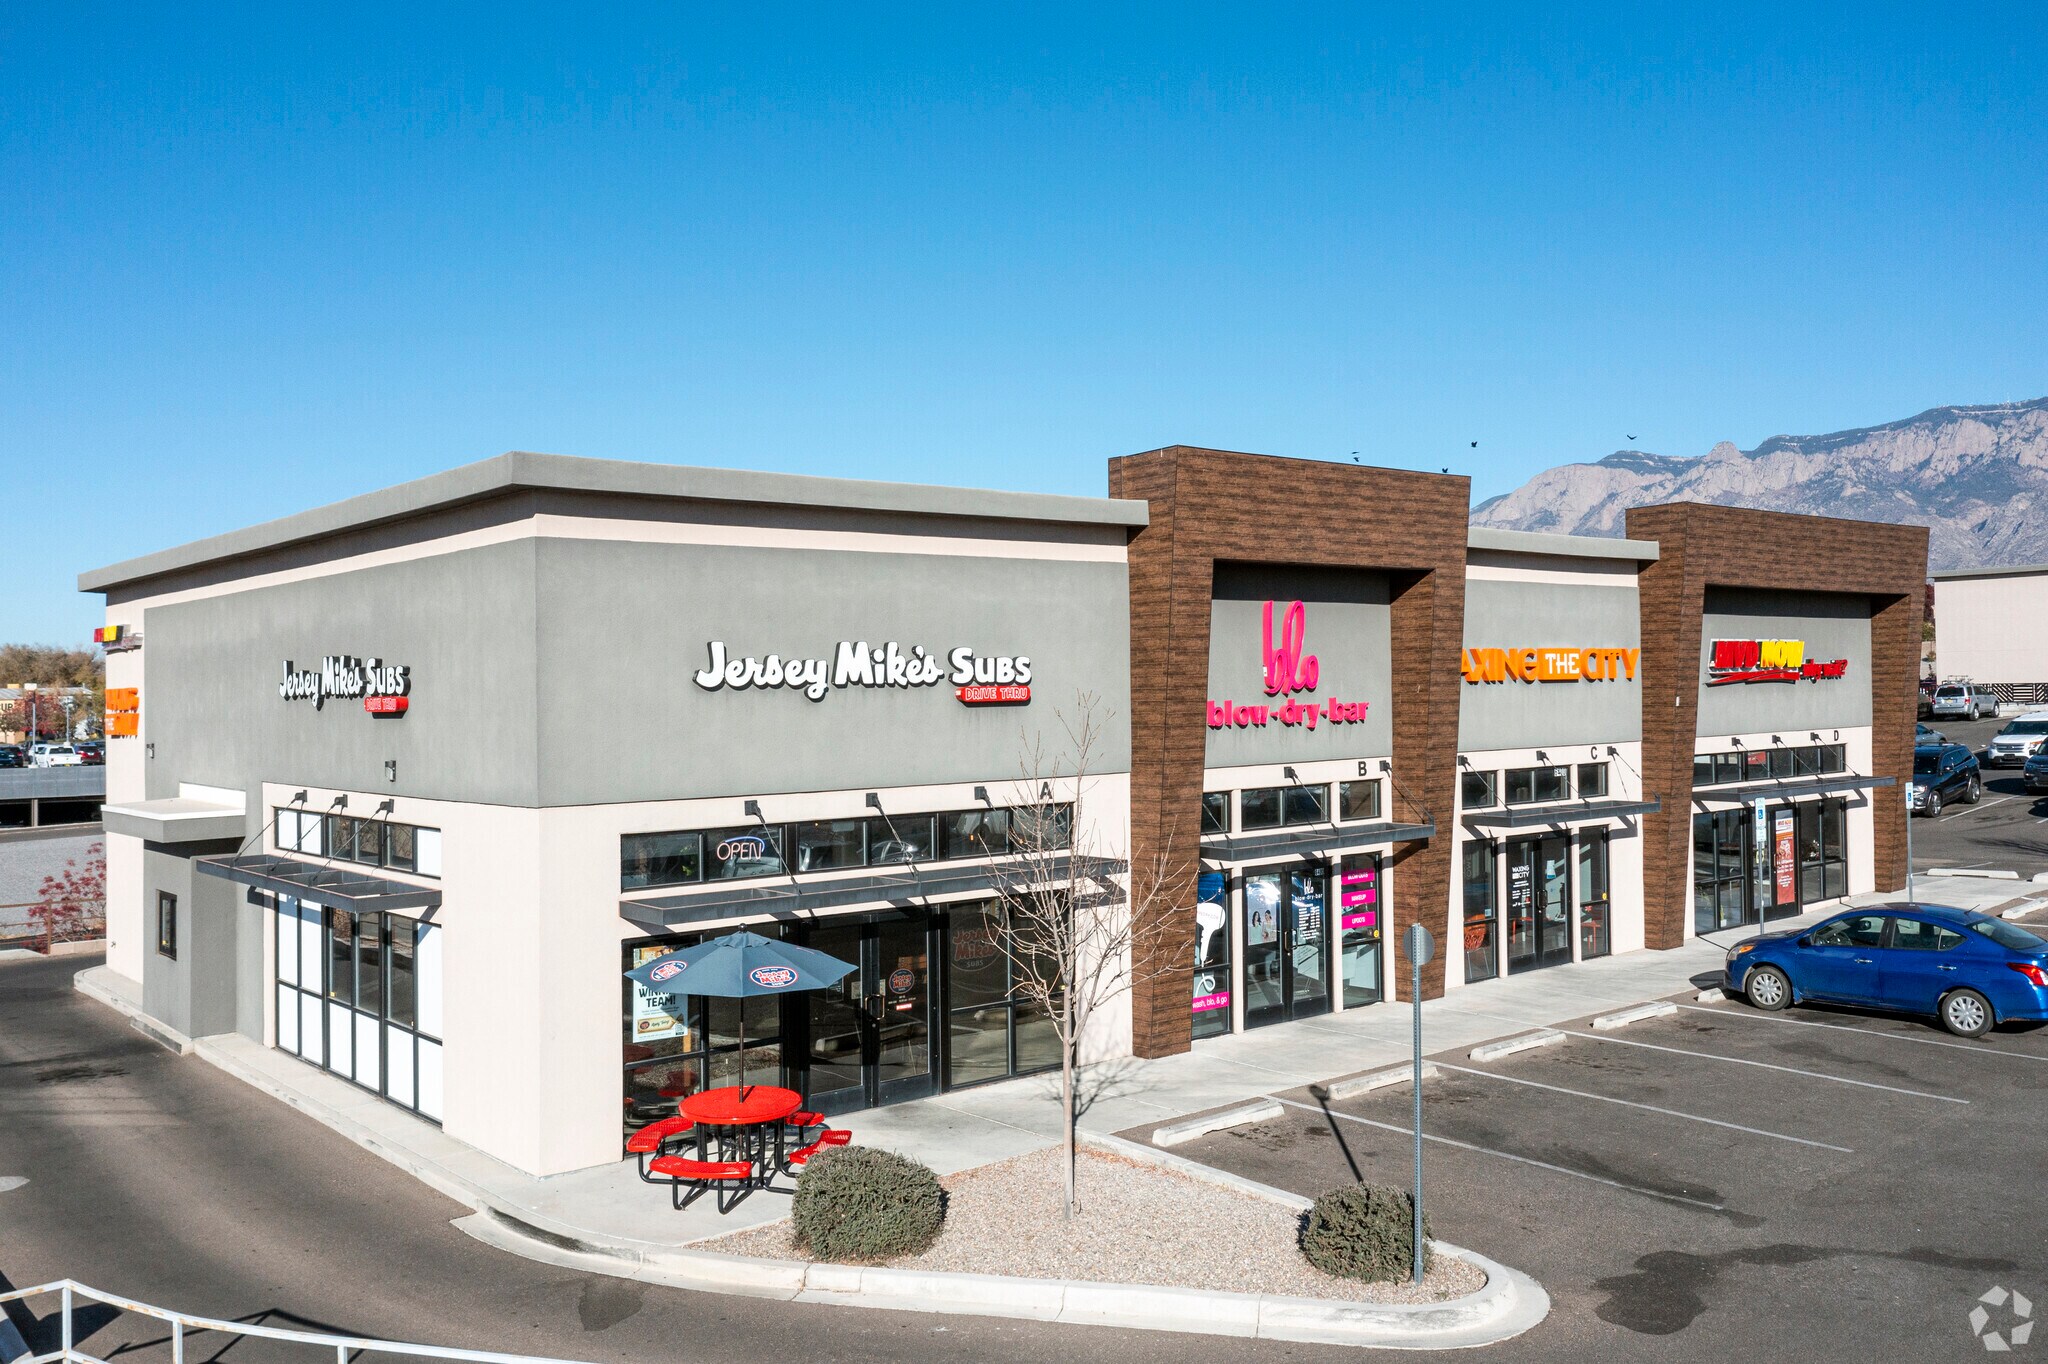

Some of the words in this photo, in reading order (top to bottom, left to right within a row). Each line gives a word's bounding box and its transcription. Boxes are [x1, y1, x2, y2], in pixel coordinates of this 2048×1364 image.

[1261, 600, 1319, 694] blo
[1715, 640, 1759, 668] MVD
[1760, 640, 1804, 668] NOW
[694, 641, 828, 699] Jersey
[833, 641, 944, 687] Mike's
[951, 646, 1032, 685] SUBS
[1461, 648, 1538, 682] AXING
[1545, 653, 1580, 674] THE
[1580, 647, 1640, 681] CITY
[280, 660, 319, 708] Jersey
[321, 656, 364, 697] Mike's
[965, 687, 997, 701] DRIVE
[1000, 687, 1028, 700] THRU
[1833, 730, 1840, 742] D
[1590, 746, 1598, 760] C
[1358, 760, 1367, 776] B
[1040, 781, 1053, 800] A
[716, 842, 762, 861] OPEN
[646, 995, 676, 1007] TEAM!
